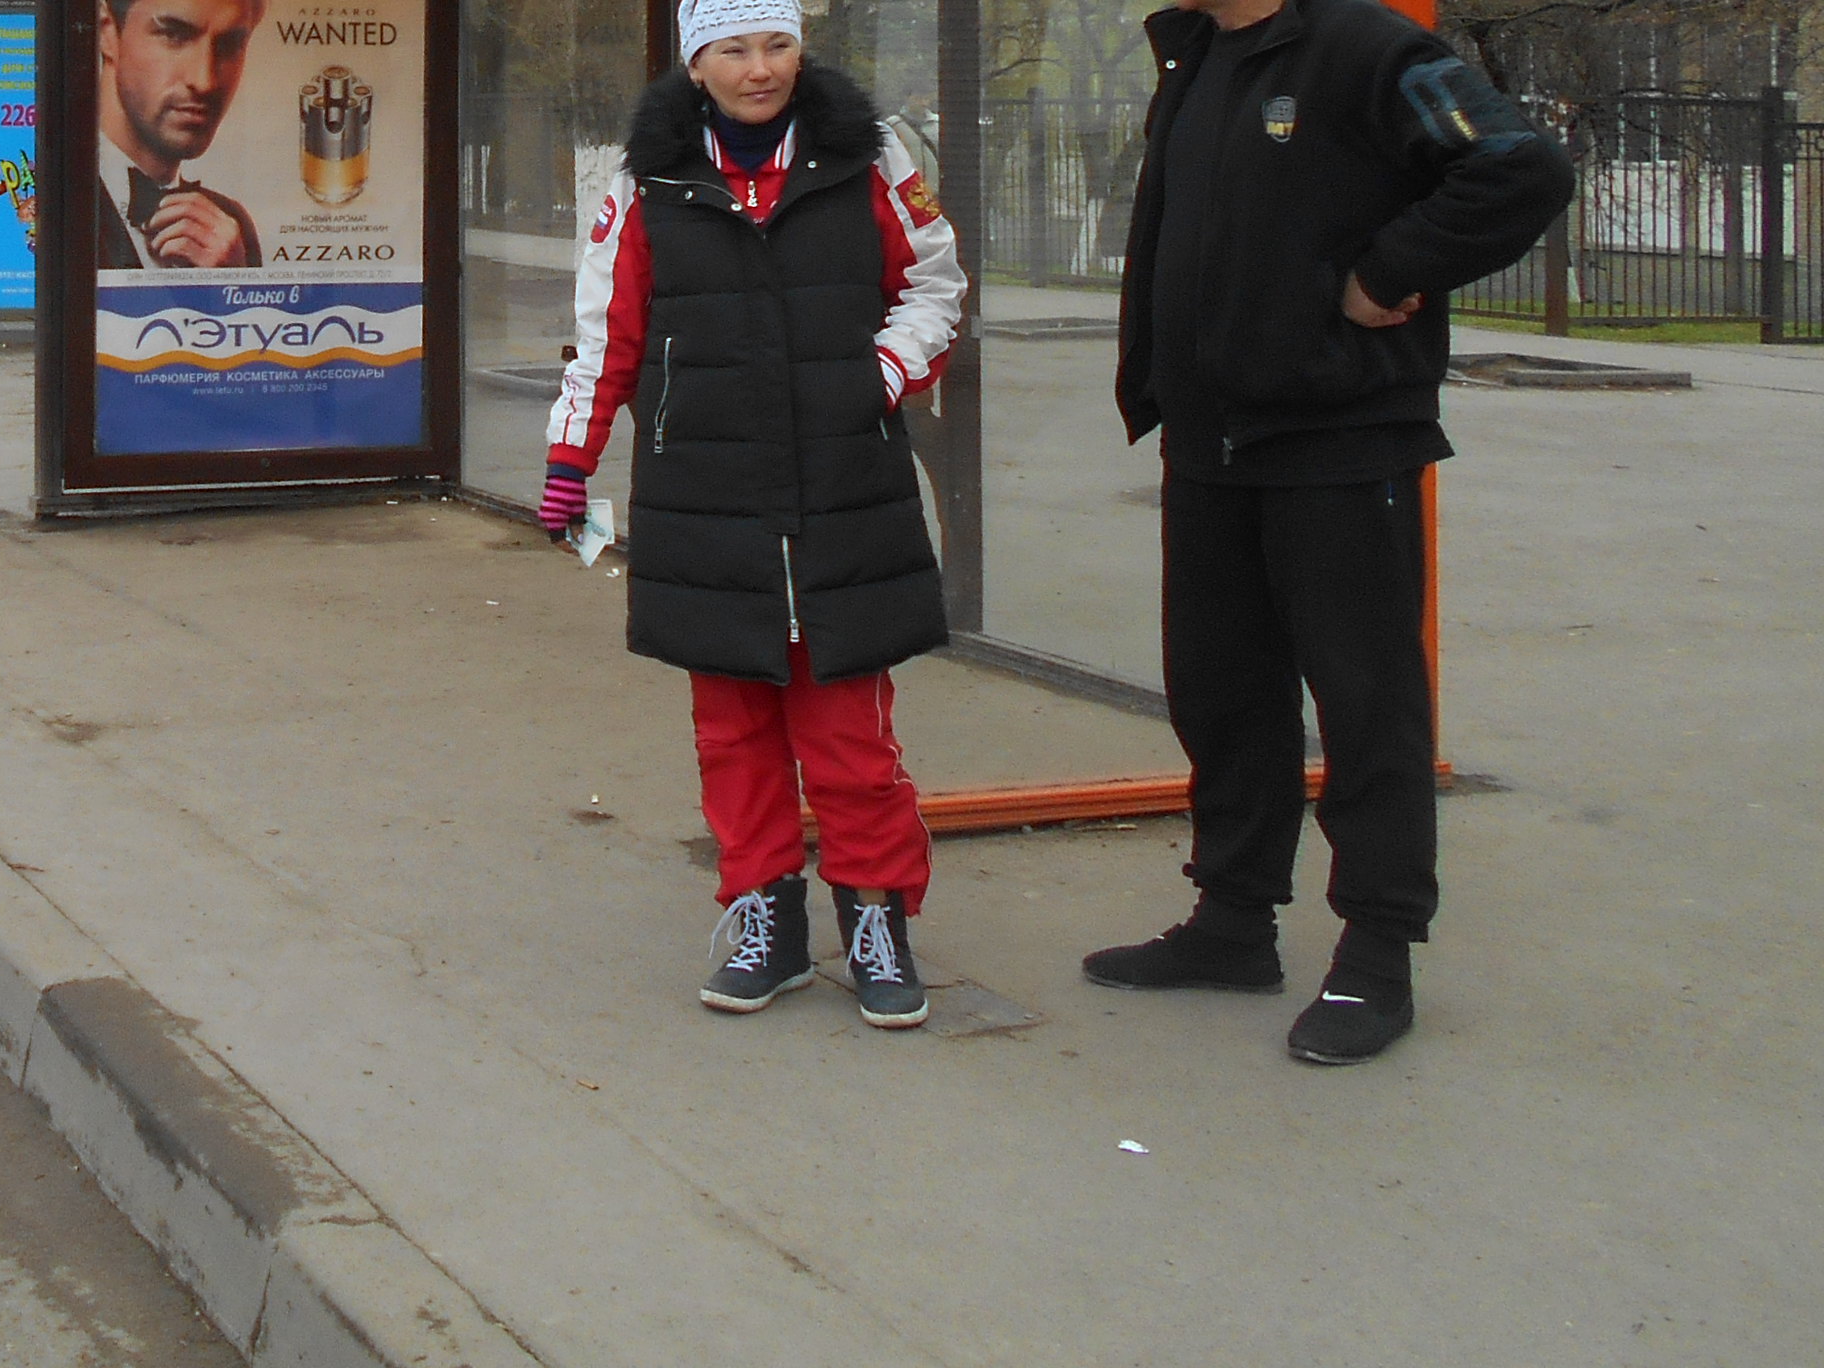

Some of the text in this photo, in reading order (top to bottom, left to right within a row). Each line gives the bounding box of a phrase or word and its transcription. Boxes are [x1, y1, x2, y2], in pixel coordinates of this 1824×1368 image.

[298, 8, 377, 16] AZZARO
[276, 21, 397, 46] WANTED
[301, 214, 368, 223] НОВЫЙ АРОМАТ
[280, 225, 389, 234] ДЛЯ НАСТОЯЩИХ МУЖЧИН
[272, 244, 395, 262] AZZARO
[222, 285, 300, 305] Только в
[134, 369, 384, 384] ПАРФЮМЕРИЯ КОСМЕТИКА АКСЕССУАРЫ
